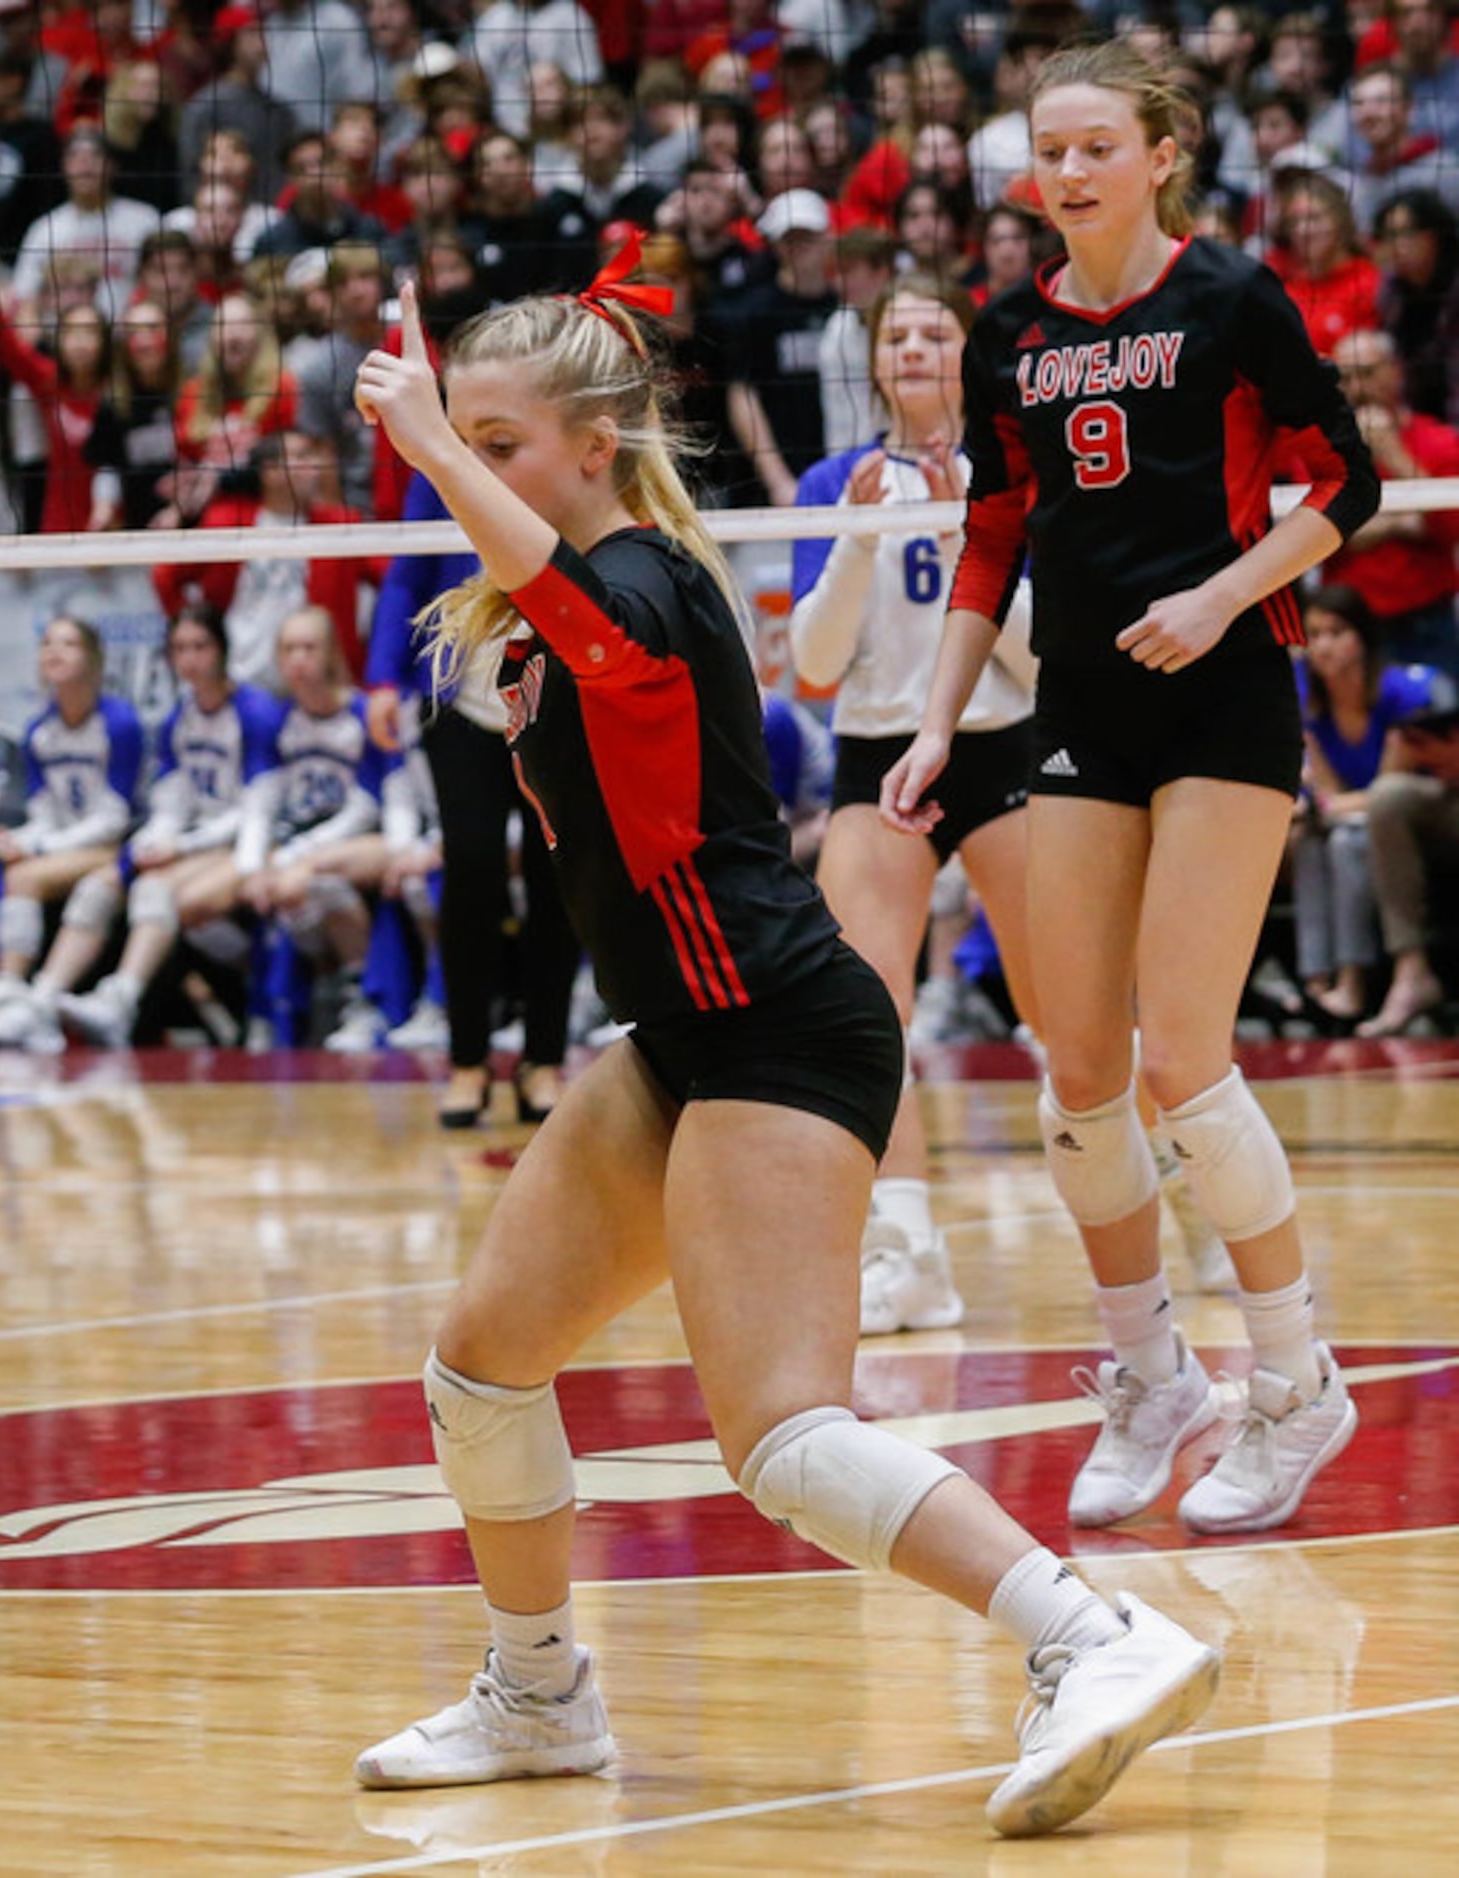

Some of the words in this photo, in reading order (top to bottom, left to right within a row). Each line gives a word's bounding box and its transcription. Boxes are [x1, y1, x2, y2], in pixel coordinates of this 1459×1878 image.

[1015, 331, 1185, 408] LOVEJOY
[1065, 399, 1131, 491] 9
[902, 536, 942, 605] 6
